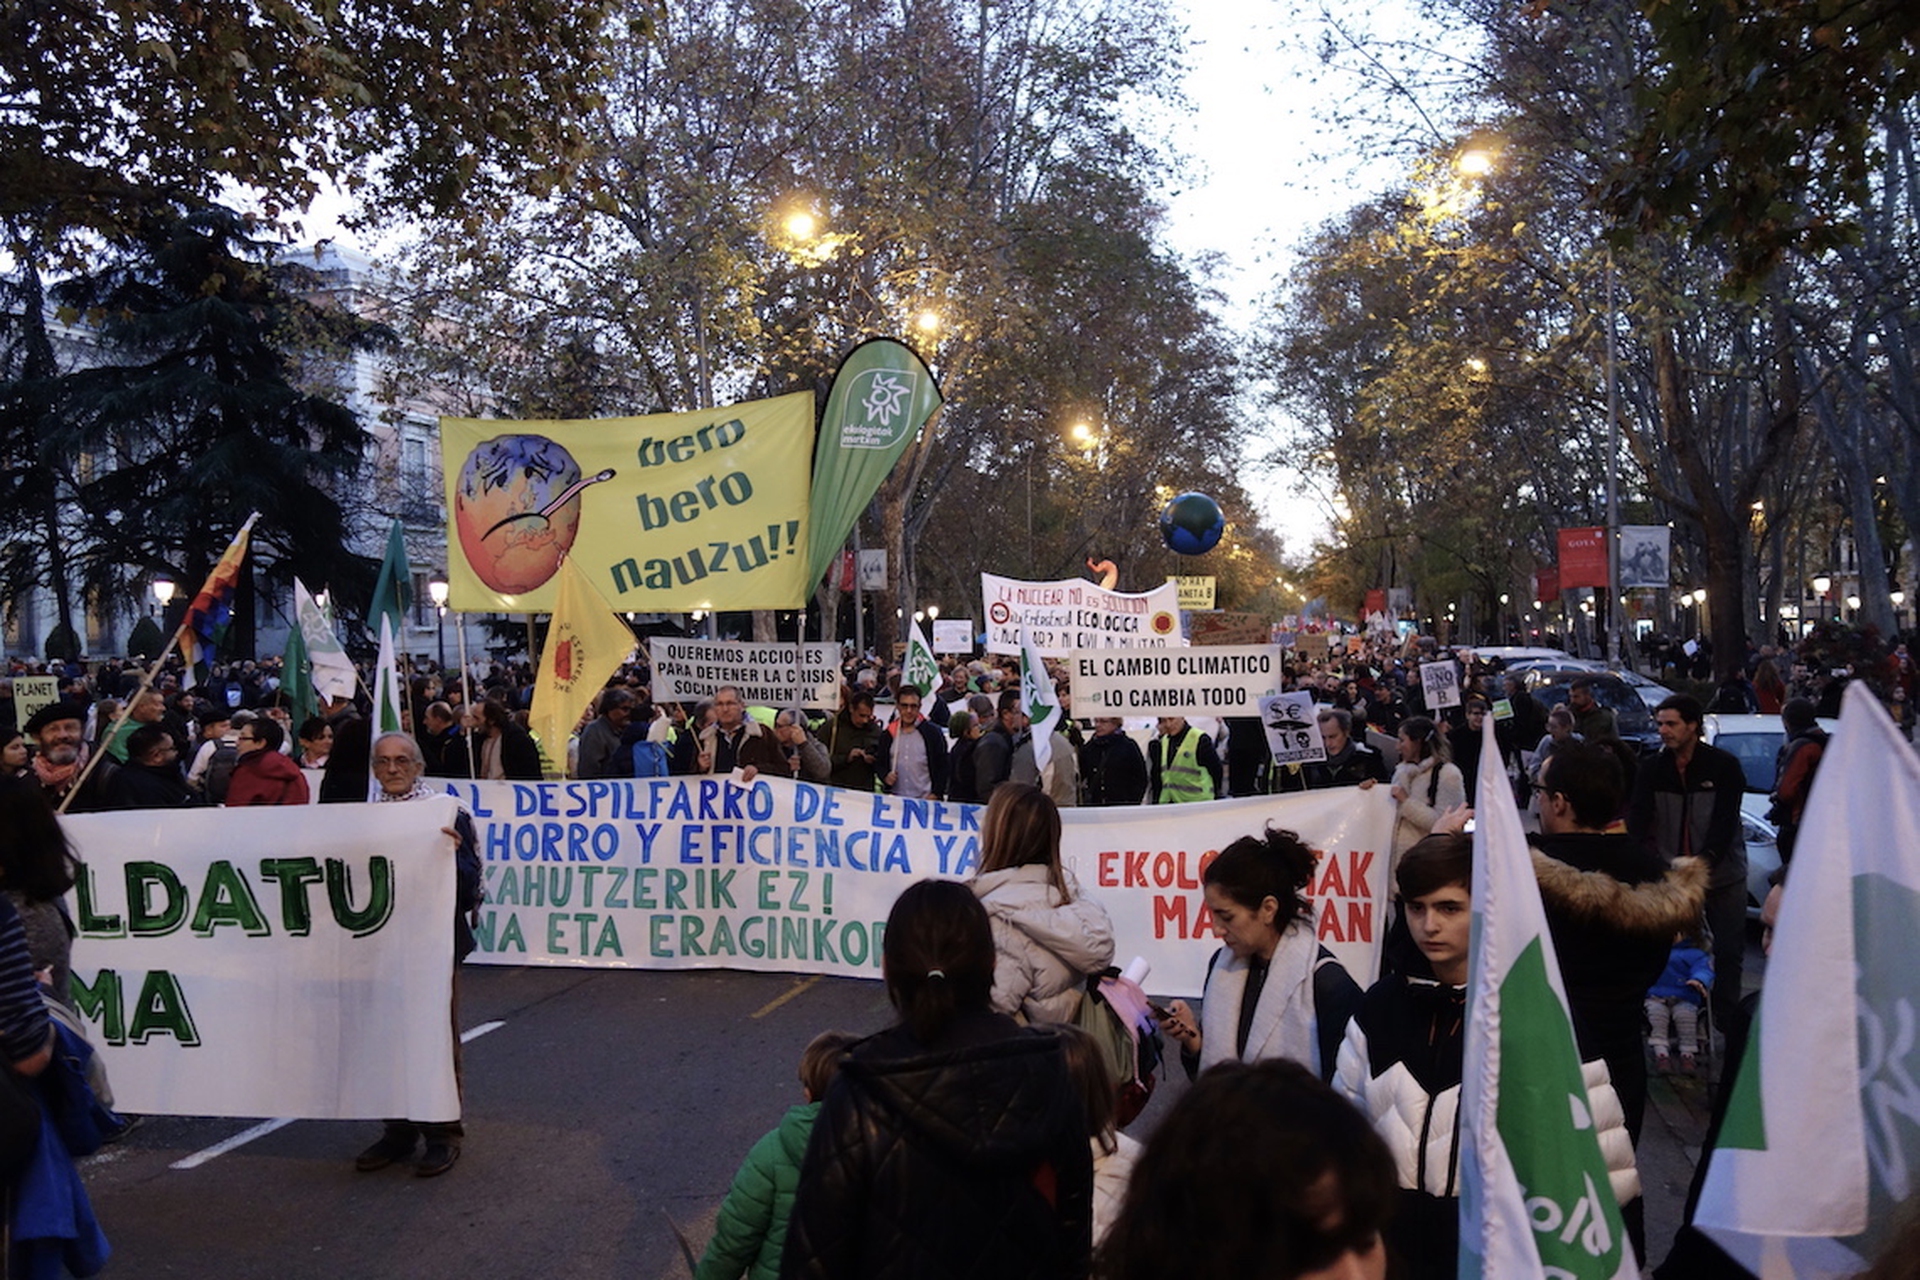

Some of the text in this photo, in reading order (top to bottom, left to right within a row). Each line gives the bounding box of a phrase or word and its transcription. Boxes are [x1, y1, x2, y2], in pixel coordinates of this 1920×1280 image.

[637, 419, 746, 467] bero
[636, 471, 753, 531] bero
[1568, 540, 1596, 548] GOYA
[610, 520, 800, 594] nauzu!!
[1017, 588, 1063, 606] NUCLEAR
[1069, 587, 1082, 605] NO
[1178, 590, 1204, 599] ANETA
[993, 627, 1053, 648] ¿NUCAR?
[667, 645, 823, 664] QUEREMOS ACCIOES
[658, 662, 835, 683] PARA DETENER LA CRISIS
[1079, 655, 1270, 677] EL CAMBIO CLIMATICO
[1435, 670, 1454, 684] NO
[16, 683, 53, 696] PLANET
[741, 687, 819, 701] AMBIENAL
[1104, 689, 1123, 707] LO
[1129, 688, 1196, 707] CAMBIA
[1202, 687, 1247, 706] TODO
[1437, 689, 1448, 704] B
[513, 780, 774, 822] DESPILFARRO
[794, 783, 847, 826] DE
[486, 823, 619, 862] HORRO
[634, 823, 663, 864] Y
[680, 825, 911, 873] EFICIENCIA
[76, 856, 395, 938] LDATU
[1154, 895, 1372, 943] MAAN
[472, 911, 527, 952] NA
[547, 912, 623, 957] ETA
[68, 969, 200, 1047] MA
